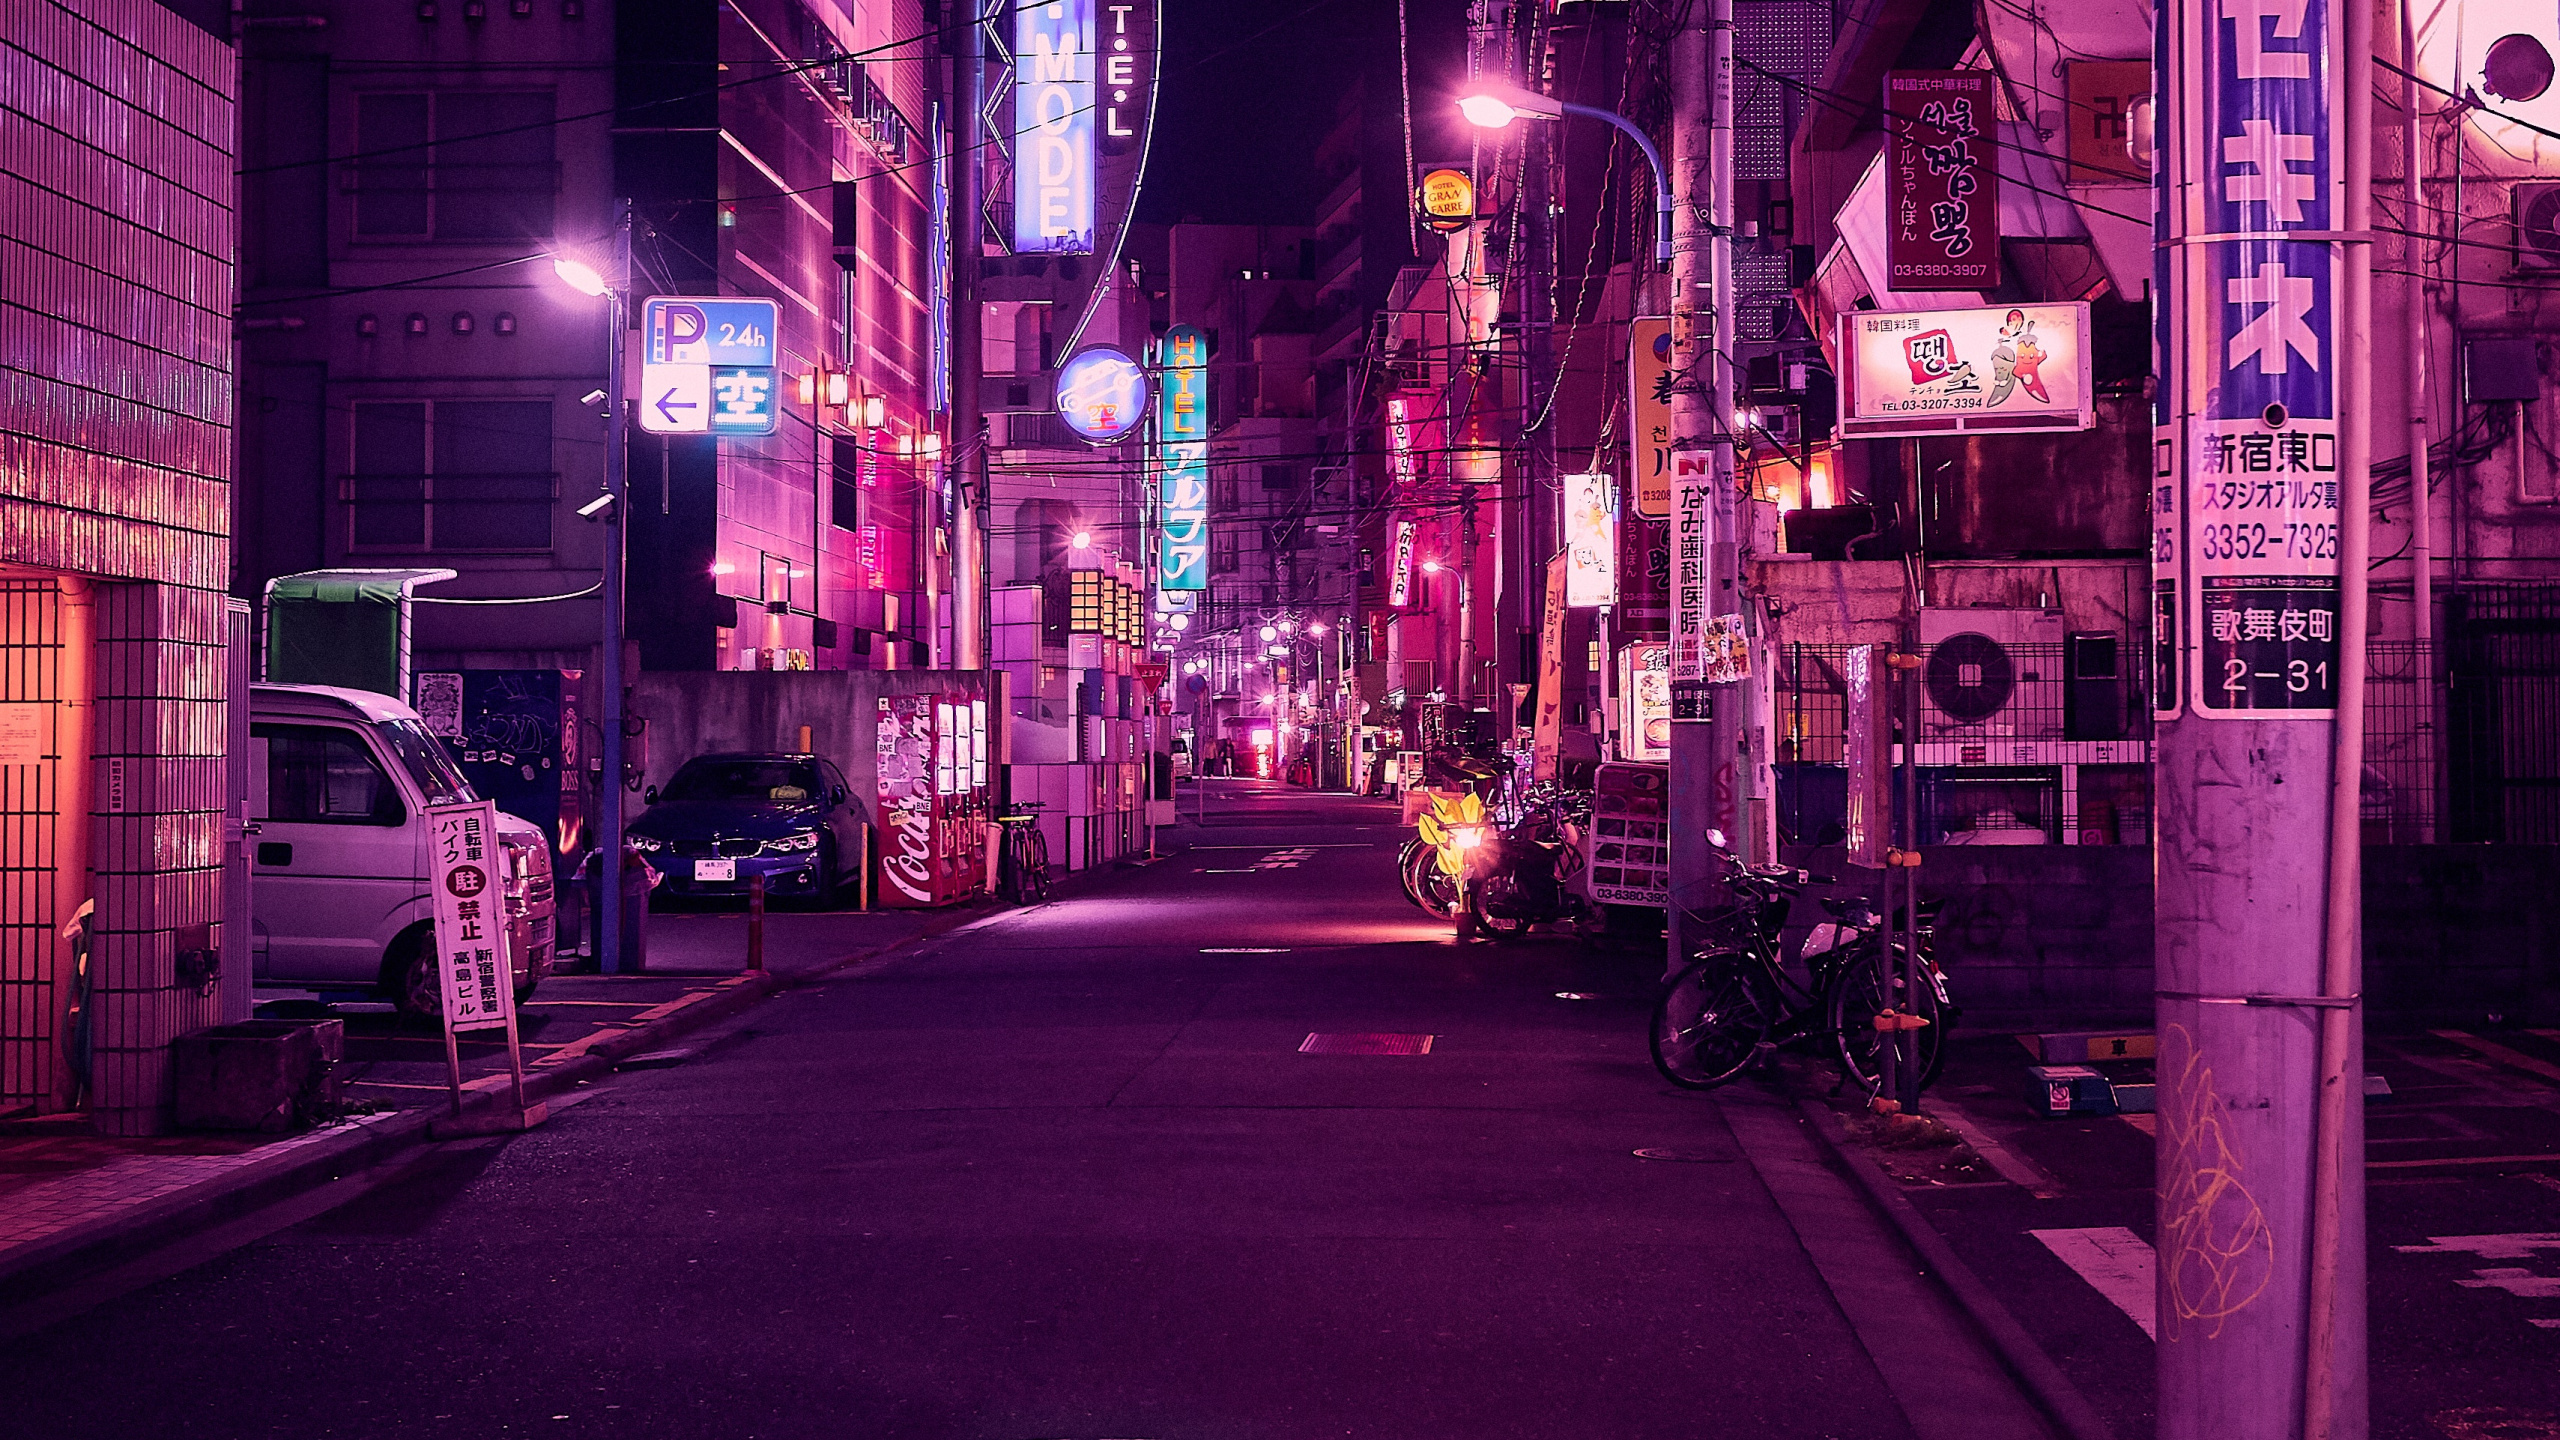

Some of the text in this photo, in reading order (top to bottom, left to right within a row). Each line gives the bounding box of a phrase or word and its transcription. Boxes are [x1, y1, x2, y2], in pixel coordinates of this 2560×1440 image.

[1892, 78, 1981, 91] 韓国式中華料理
[1035, 33, 1075, 237] MODE
[1429, 189, 1462, 202] GRAN
[1432, 182, 1455, 190] HOTEL
[1900, 120, 1917, 241] ソウルちゃんぽん
[1431, 202, 1463, 214] FARRE
[1894, 264, 1987, 276] 03-6380-3907
[665, 305, 766, 362] P 24h
[1867, 319, 1920, 332] 韓国料理
[714, 369, 769, 423] 空
[1174, 334, 1196, 432] HOTEL
[1086, 403, 1120, 430] 空
[2203, 431, 2335, 474] 新宿東口
[2202, 480, 2338, 511] スタジオアルタ裏
[2203, 523, 2338, 560] 3352-7325
[2211, 608, 2334, 643] 歌舞伎町
[2222, 659, 2327, 692] 2-31
[879, 744, 893, 753] BNE
[561, 770, 579, 791] BOSS
[916, 802, 930, 811] BNE
[441, 820, 460, 863] バイク
[464, 817, 484, 862] 自転車
[455, 872, 479, 893] 駐
[458, 899, 483, 942] 禁止
[453, 951, 475, 1017] 高島ビル
